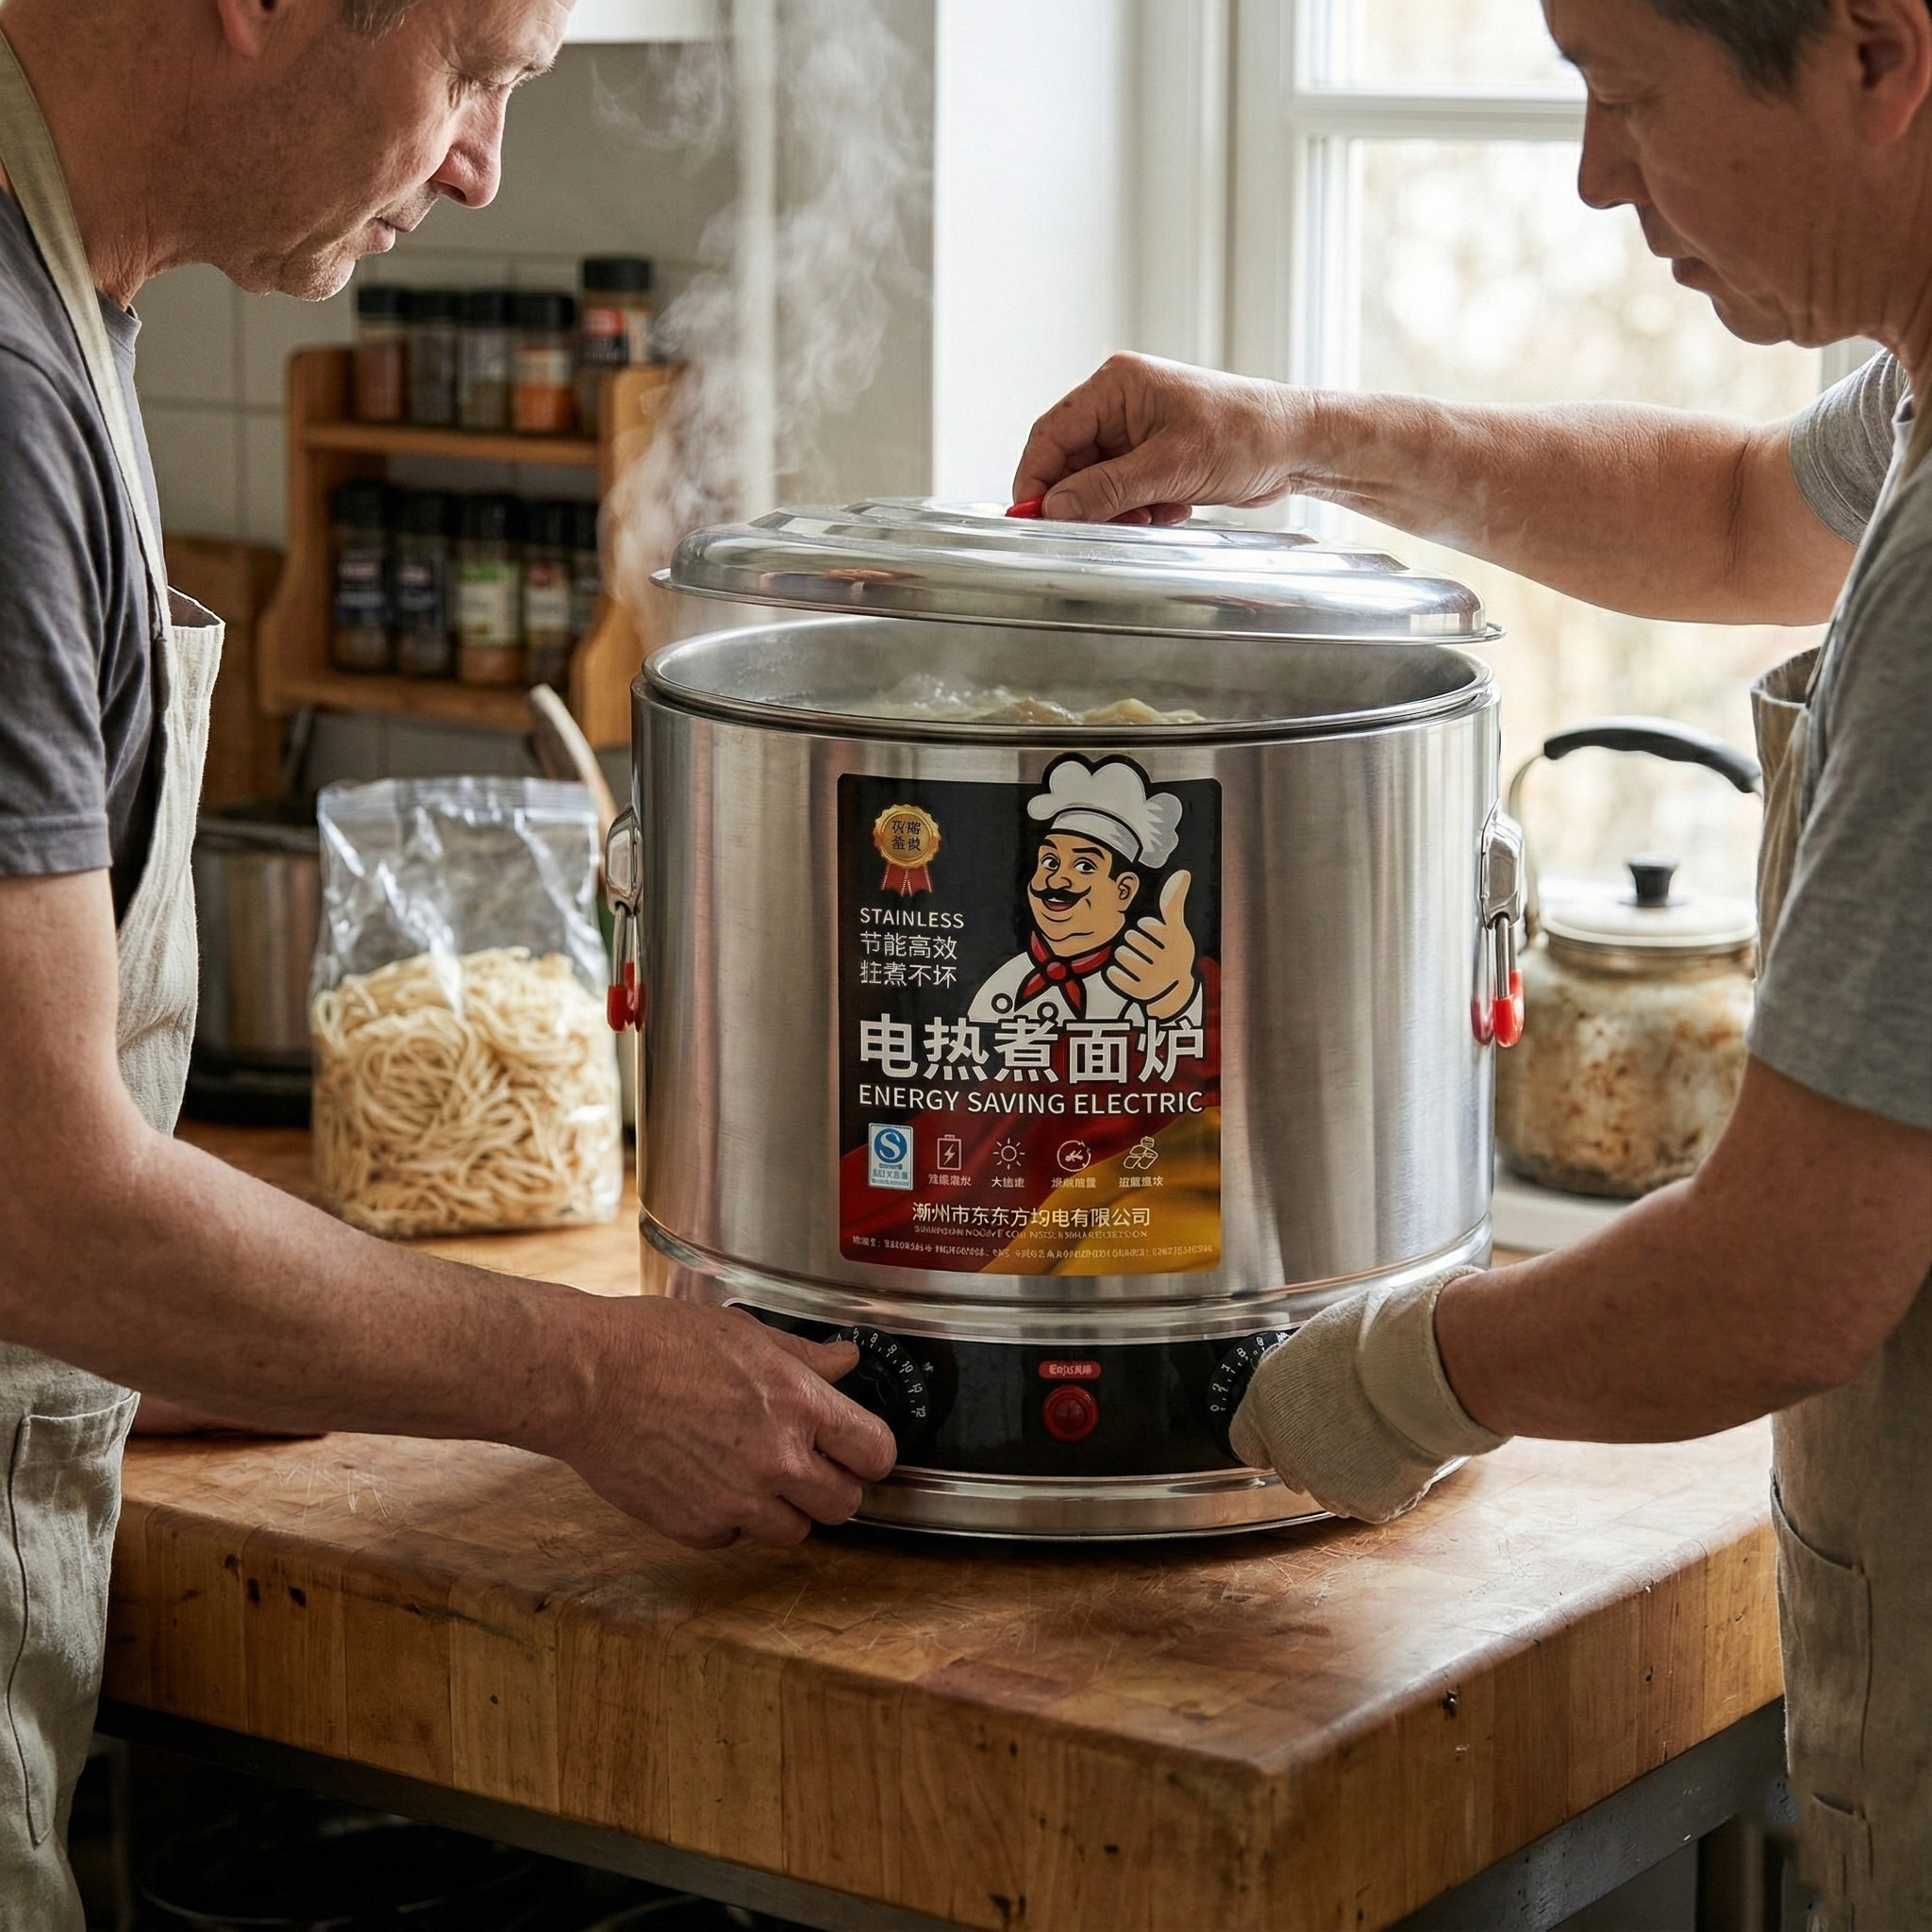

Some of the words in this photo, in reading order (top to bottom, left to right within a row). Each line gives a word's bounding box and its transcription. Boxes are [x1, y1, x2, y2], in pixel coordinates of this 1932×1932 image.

[859, 908, 965, 929] STAINLESS
[859, 930, 958, 960] 节能高效
[859, 1012, 1205, 1084] 电热煮面炉
[859, 1084, 959, 1112] ENERGY
[967, 1091, 1065, 1114] SAVING
[1074, 1091, 1204, 1115] ELECTRIC
